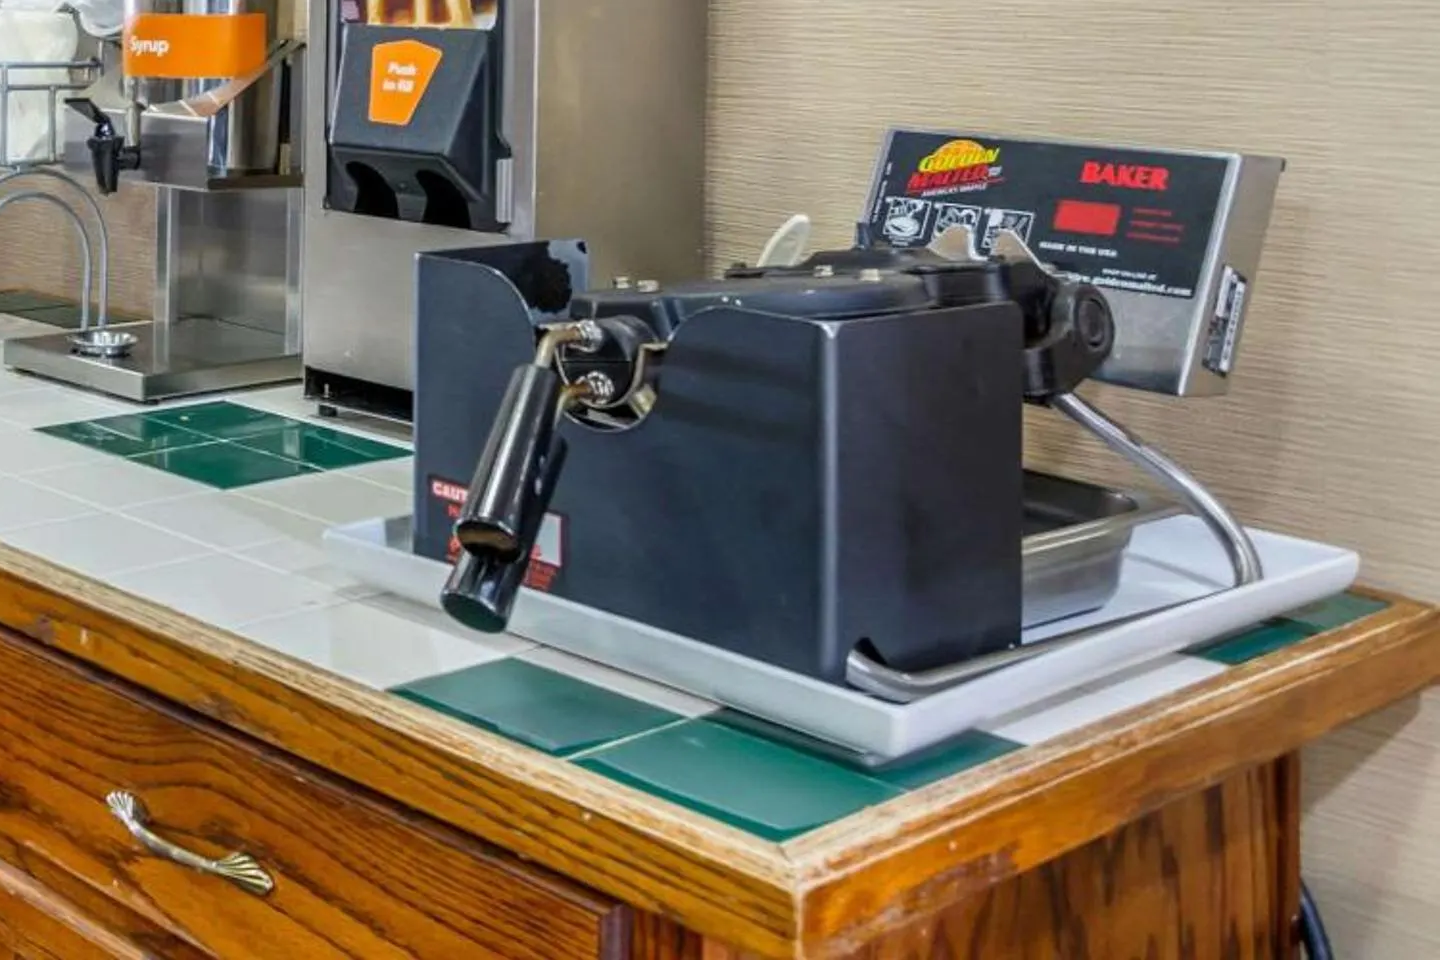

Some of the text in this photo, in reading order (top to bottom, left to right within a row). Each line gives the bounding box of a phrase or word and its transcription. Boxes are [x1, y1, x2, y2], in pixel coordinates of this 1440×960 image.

[130, 34, 170, 57] Syrup
[387, 59, 418, 76] Push
[918, 146, 1001, 173] GOLDEN
[908, 163, 990, 190] MALTED
[1079, 159, 1170, 190] BAKER
[432, 480, 469, 503] CAUT
